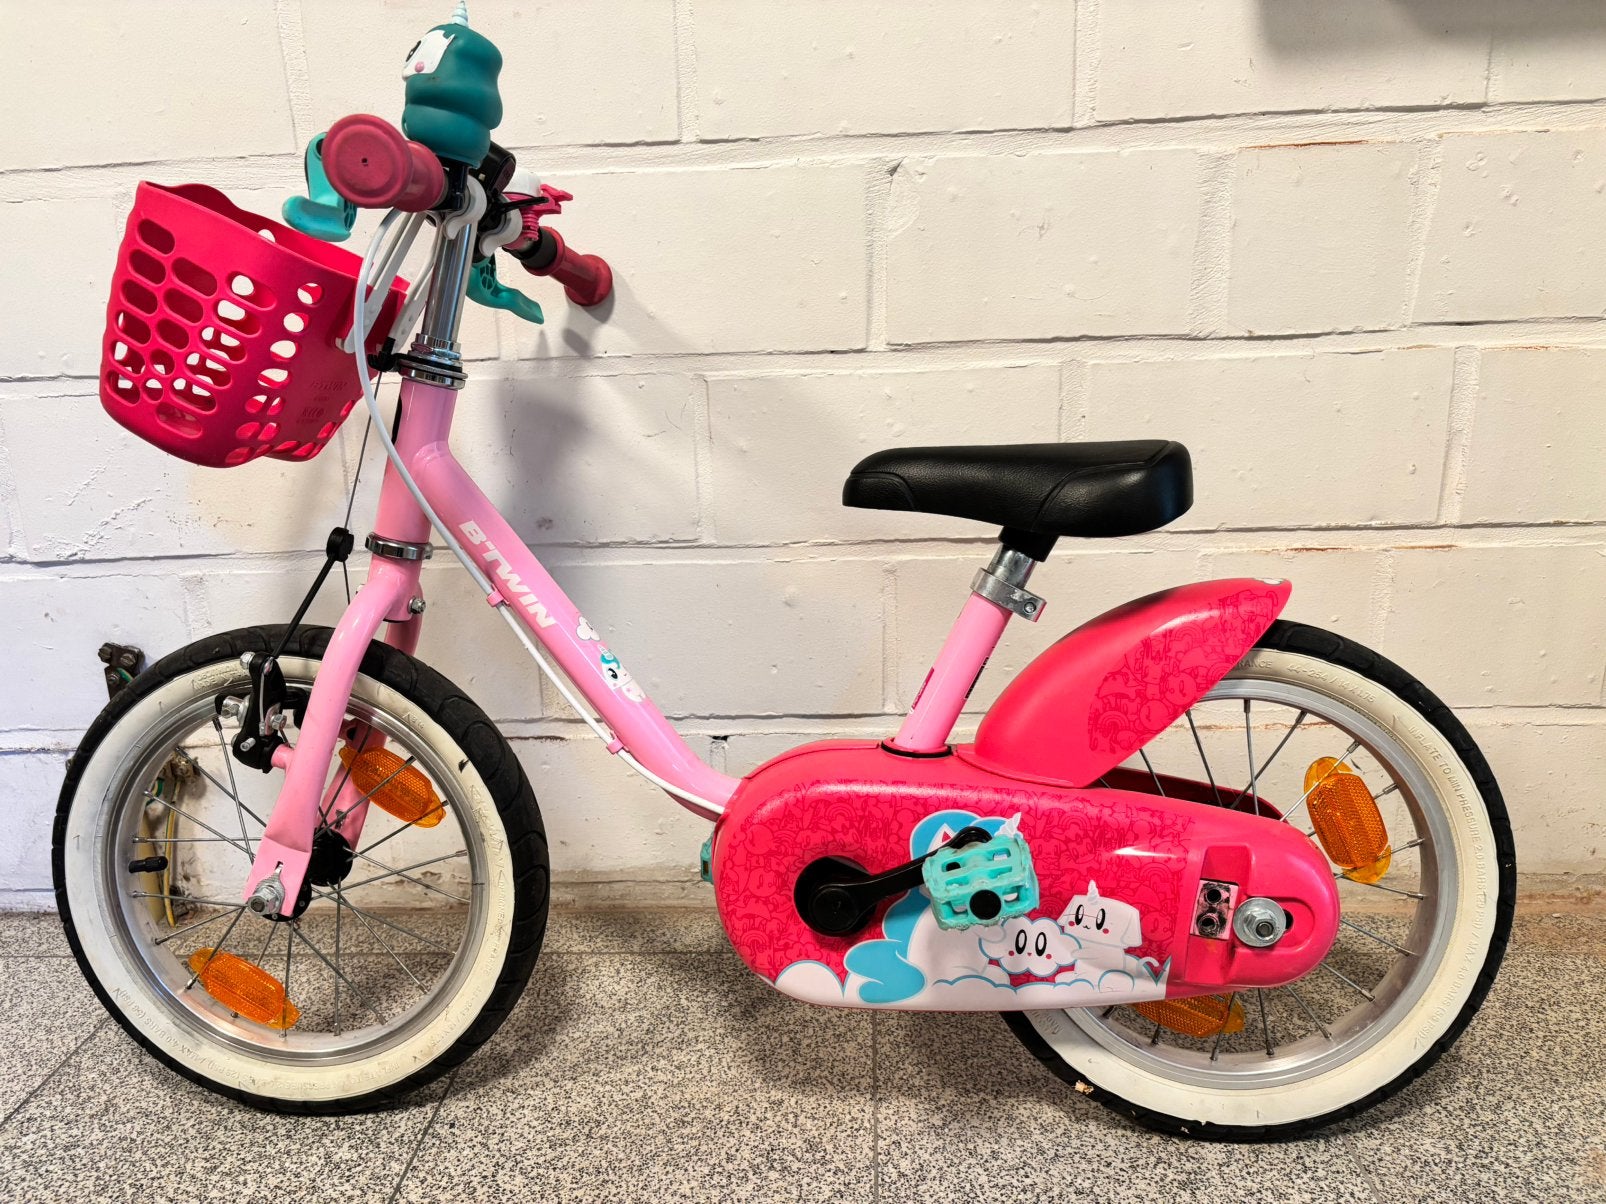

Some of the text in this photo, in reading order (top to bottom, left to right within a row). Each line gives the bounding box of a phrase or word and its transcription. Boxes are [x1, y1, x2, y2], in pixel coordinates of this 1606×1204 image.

[1235, 660, 1271, 668] RANCE
[1407, 724, 1442, 760] INFLATE
[1439, 760, 1452, 775] TO
[1447, 773, 1462, 791] MIN
[1456, 790, 1481, 842] PRESSURE
